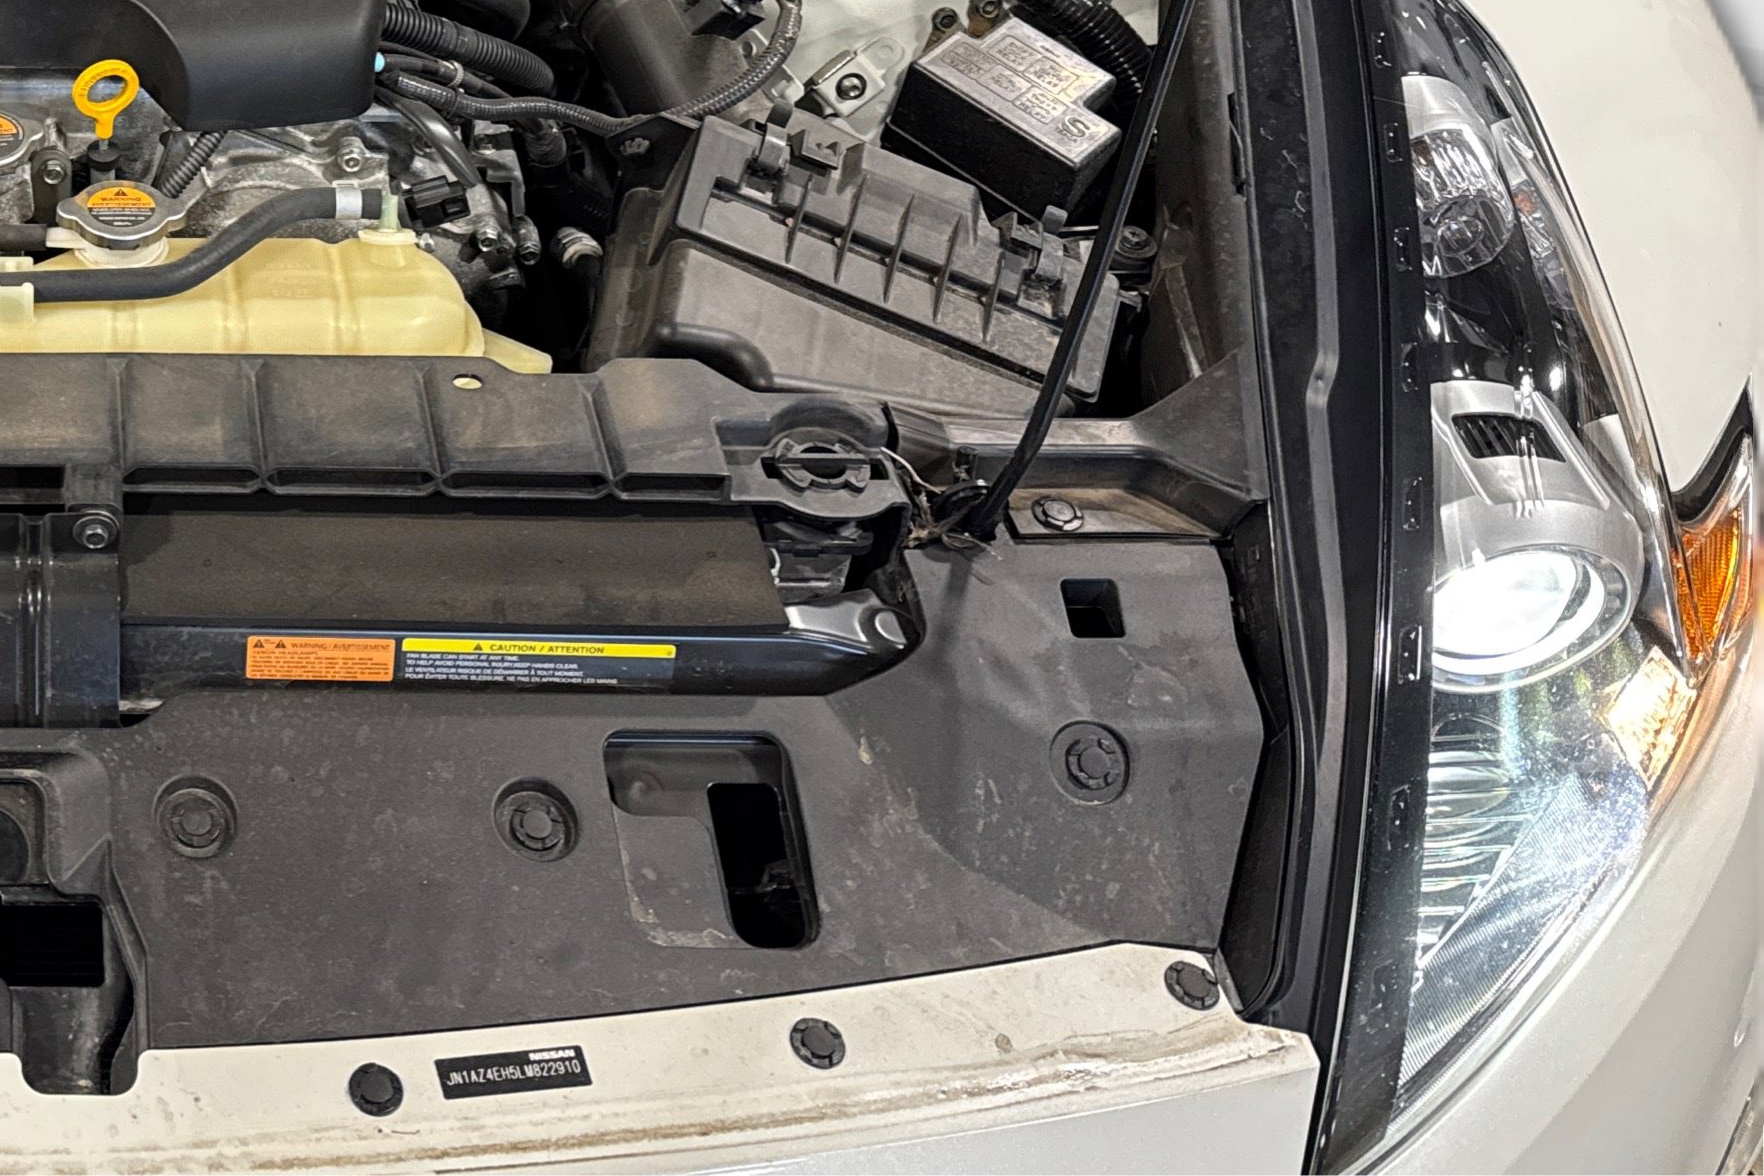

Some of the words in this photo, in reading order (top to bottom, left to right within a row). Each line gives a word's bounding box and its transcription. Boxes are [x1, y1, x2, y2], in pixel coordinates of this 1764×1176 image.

[291, 642, 328, 650] WARNING
[489, 643, 536, 653] CAUTION
[547, 645, 605, 655] ATTENTION
[528, 1049, 576, 1061] NISSAN
[446, 1059, 582, 1086] JN1AZ4EH5LM822910
